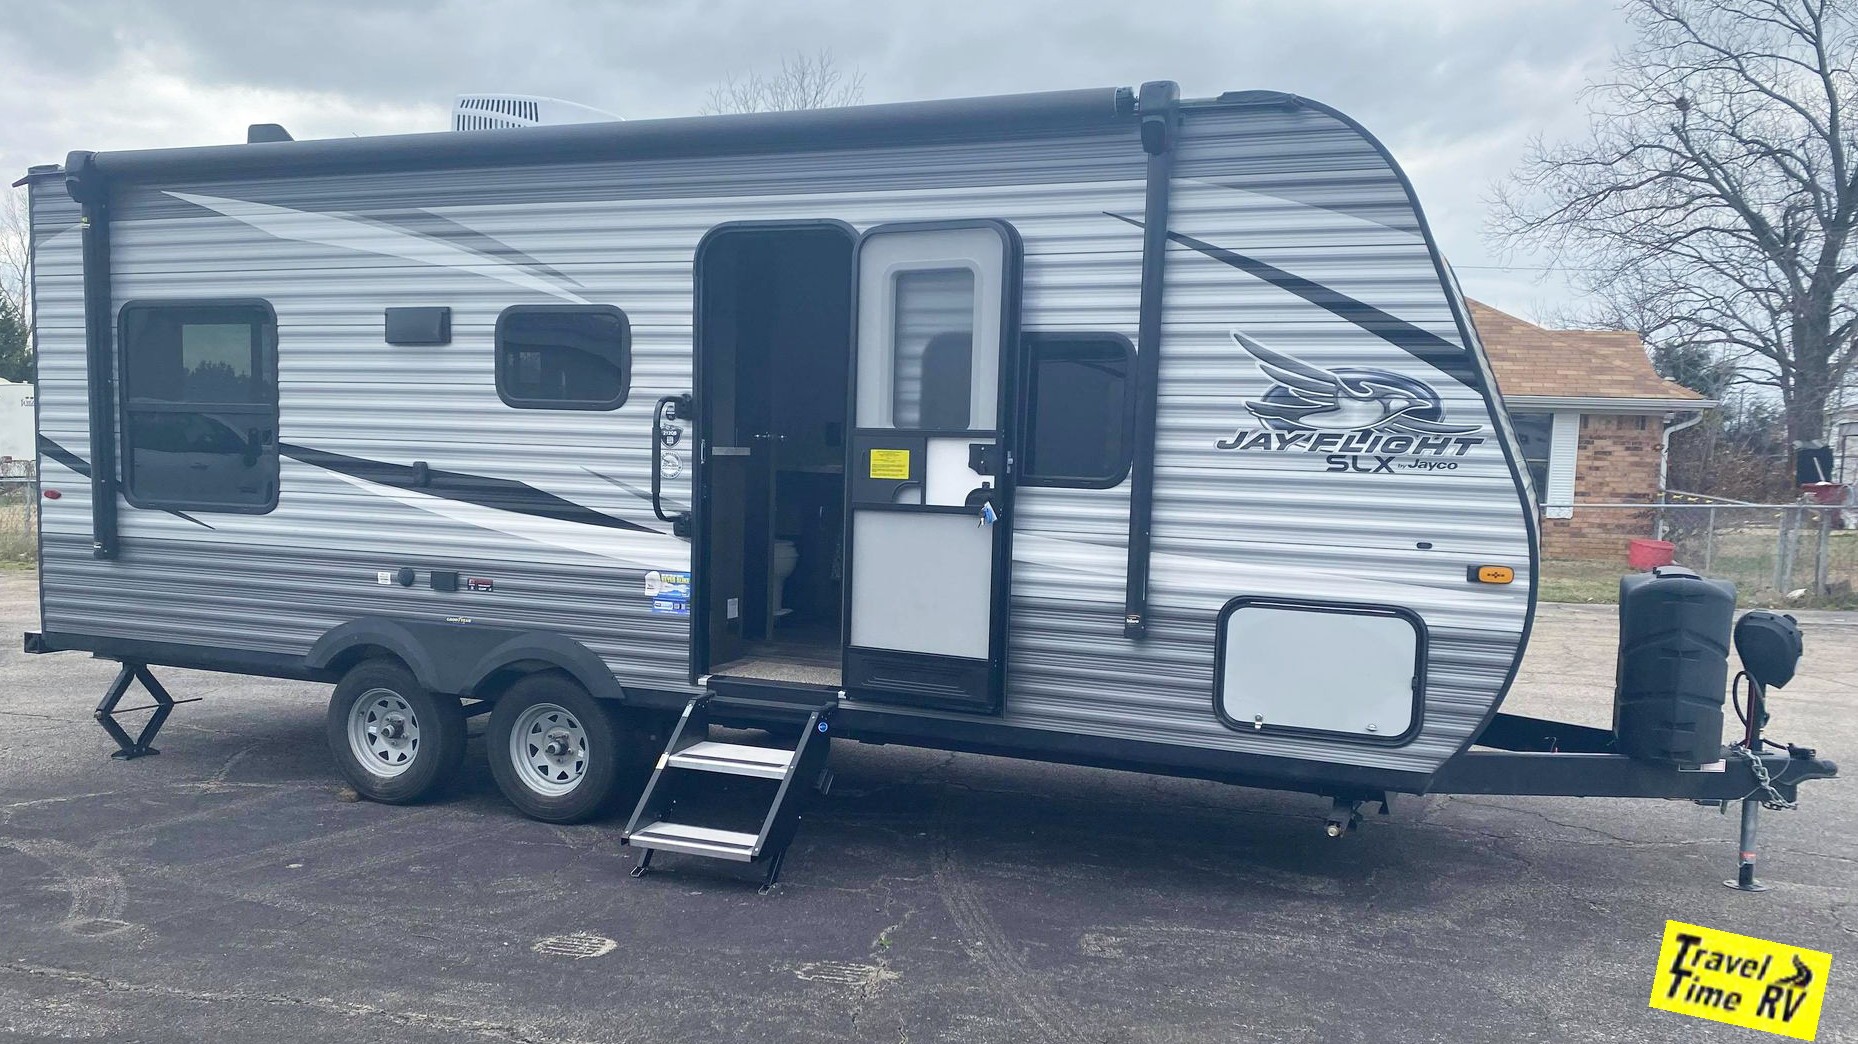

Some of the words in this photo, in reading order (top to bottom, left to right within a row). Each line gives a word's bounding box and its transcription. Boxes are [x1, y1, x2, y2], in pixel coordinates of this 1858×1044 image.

[1216, 430, 1306, 451] JAY
[1305, 431, 1485, 456] FLIGHT
[1326, 454, 1395, 473] SLX
[1408, 458, 1458, 471] Jayco
